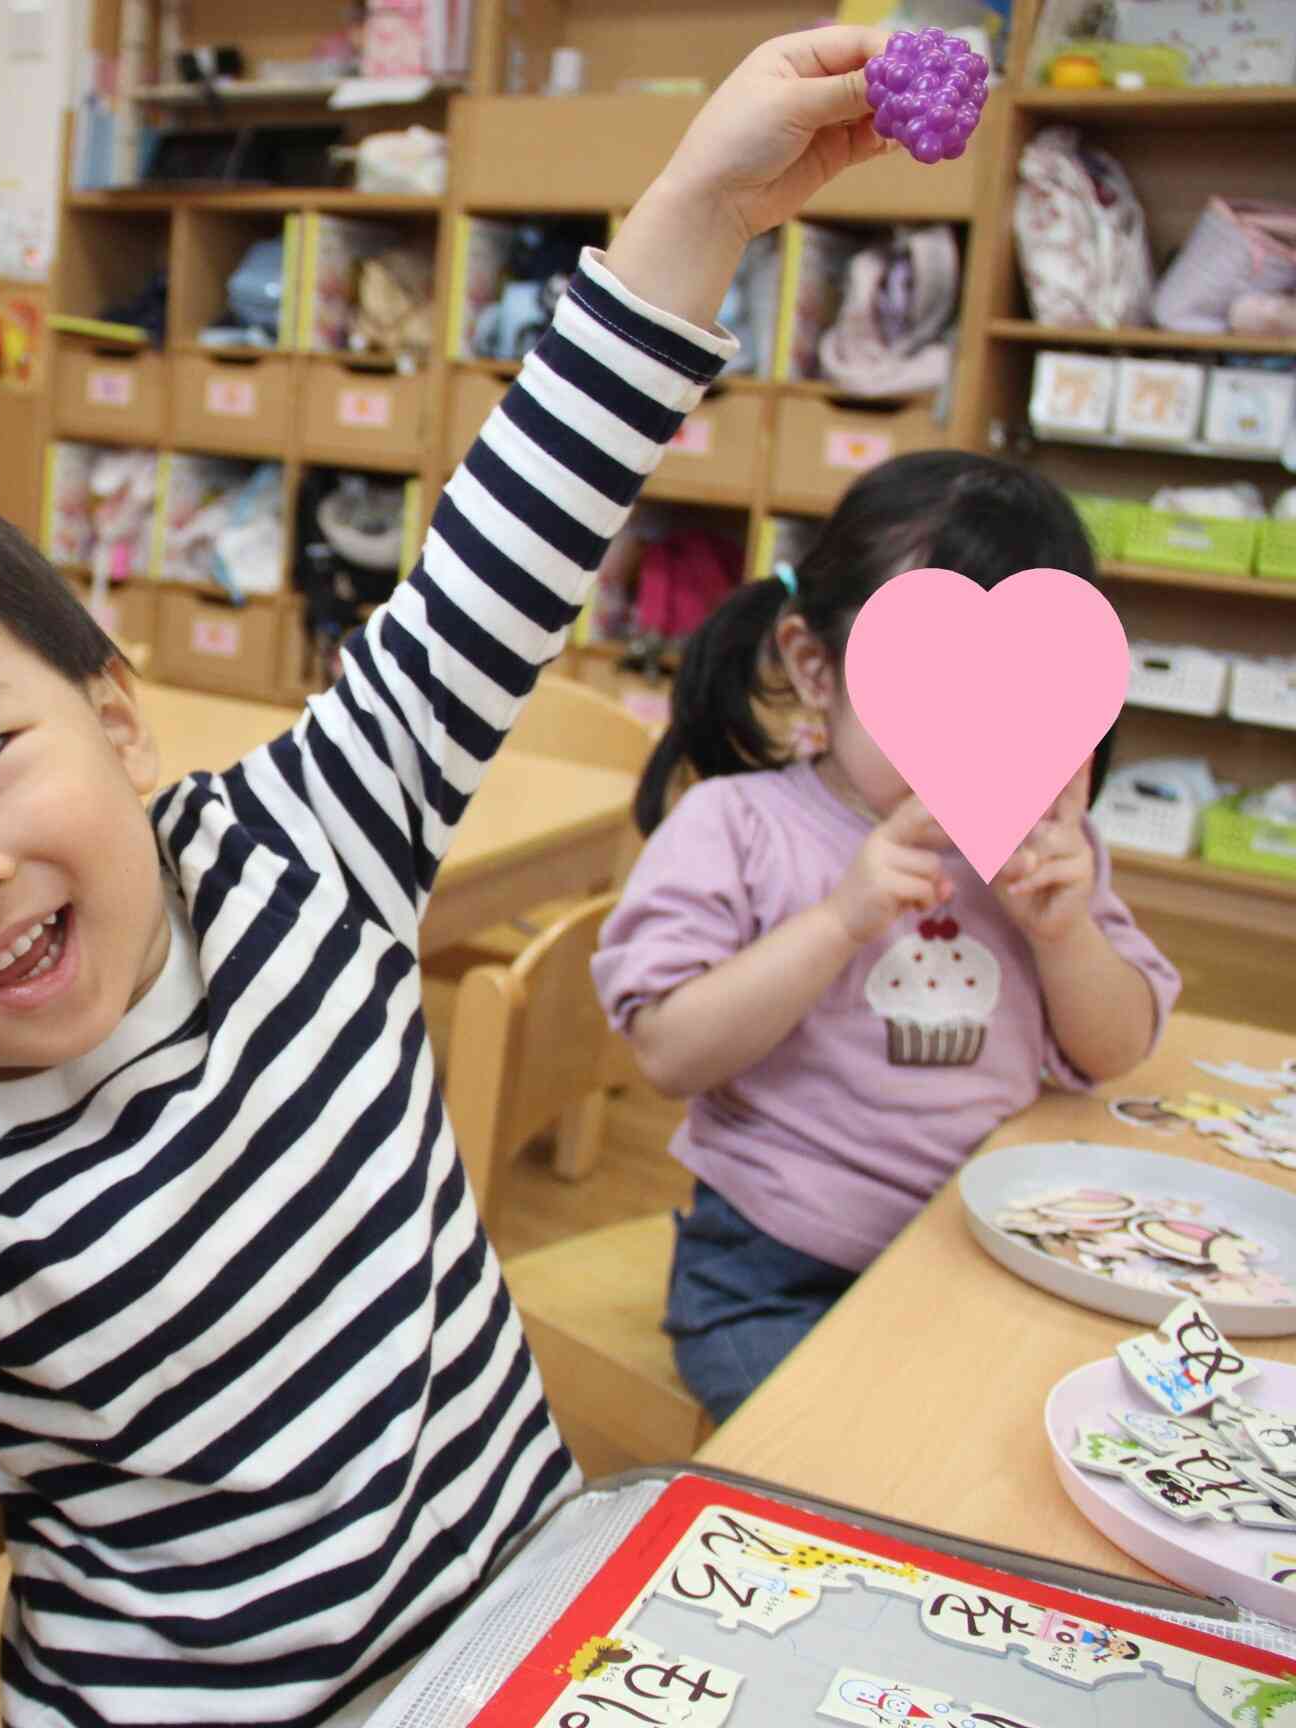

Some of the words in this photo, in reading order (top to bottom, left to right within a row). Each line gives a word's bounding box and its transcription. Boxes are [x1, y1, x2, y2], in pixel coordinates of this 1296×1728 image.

[1176, 1311, 1244, 1386] ぬ
[700, 1513, 788, 1558] ん
[671, 1562, 759, 1608] ろ
[929, 1592, 1030, 1637] を
[623, 1663, 728, 1702] も
